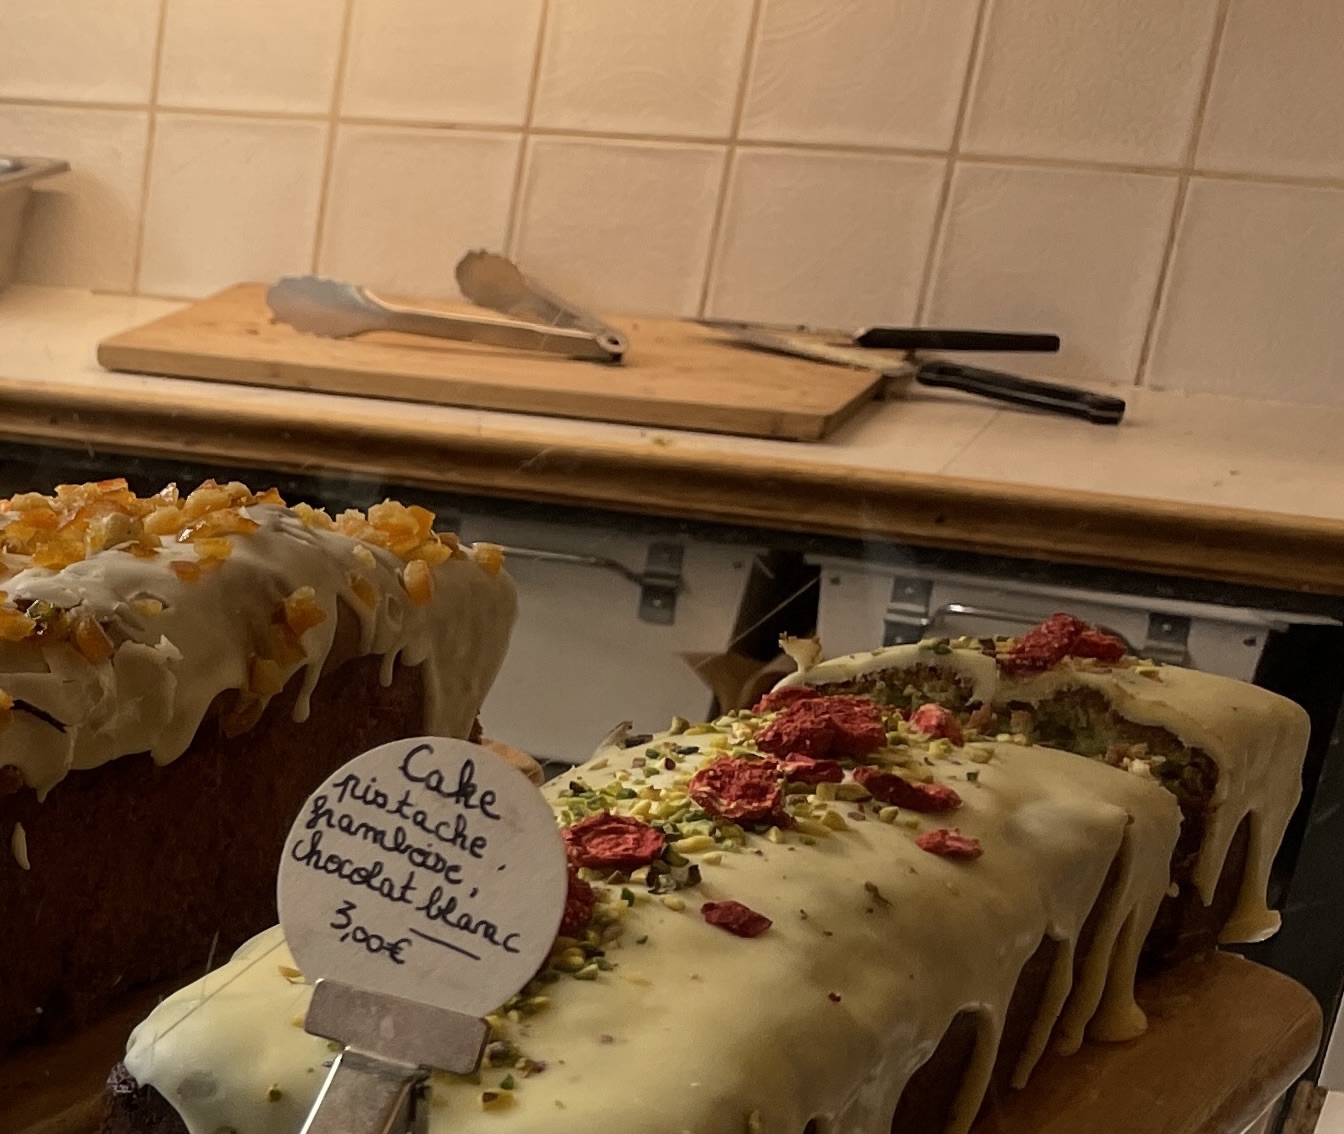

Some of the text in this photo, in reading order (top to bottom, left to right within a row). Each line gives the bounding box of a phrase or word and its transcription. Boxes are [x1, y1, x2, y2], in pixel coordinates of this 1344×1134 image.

[400, 744, 501, 821] Cake
[292, 830, 521, 954] chocolat blanc
[330, 900, 412, 964] 3,00€
